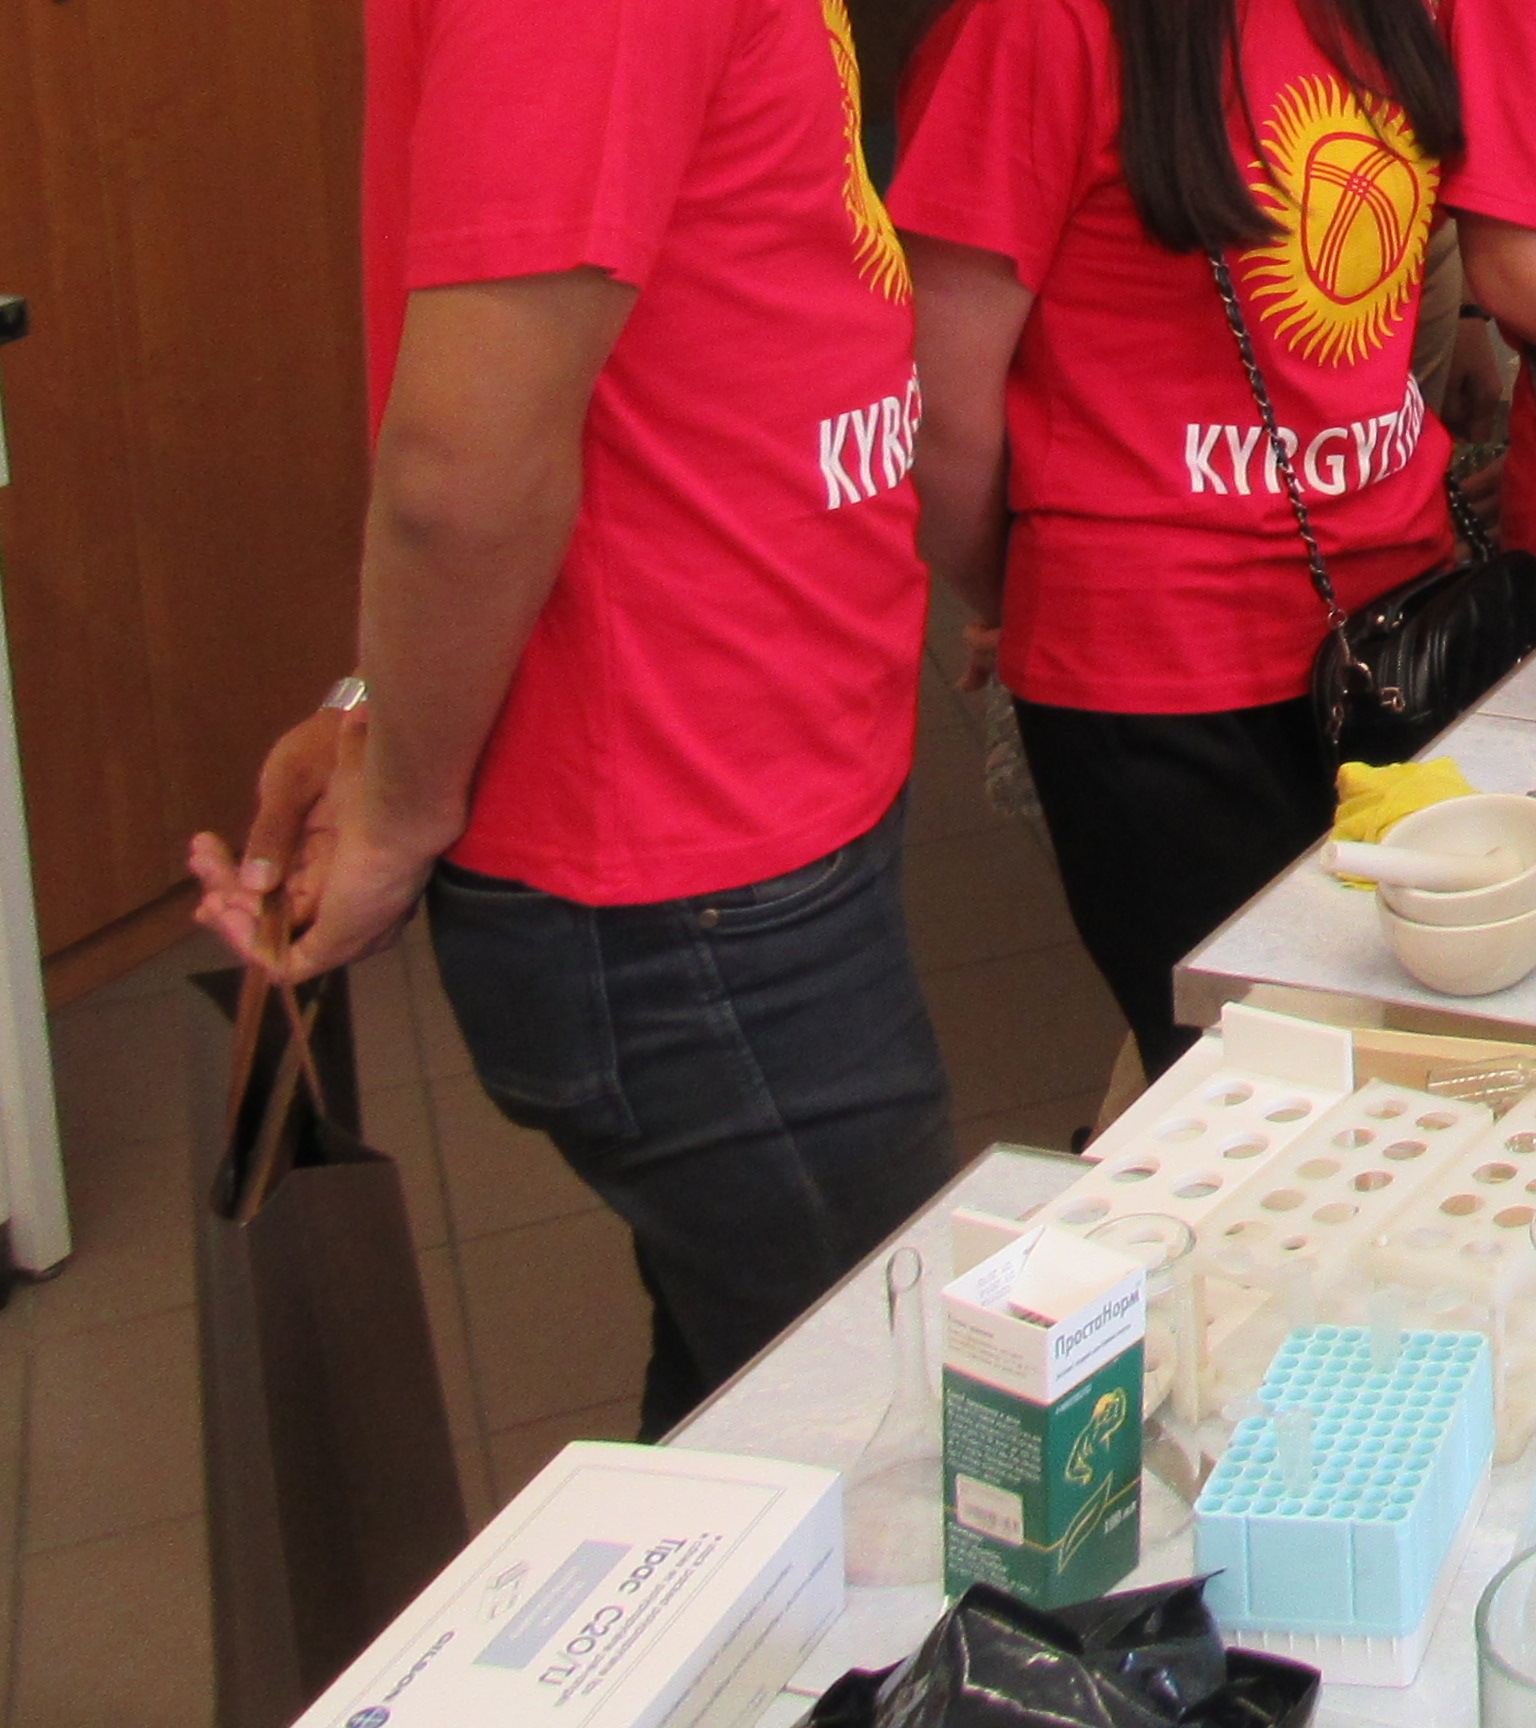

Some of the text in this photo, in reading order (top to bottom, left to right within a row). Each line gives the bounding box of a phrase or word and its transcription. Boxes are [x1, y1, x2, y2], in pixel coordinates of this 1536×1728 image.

[820, 372, 922, 511] KYRG
[1055, 1288, 1140, 1359] ПростаНорм
[617, 1537, 688, 1595] Tipac
